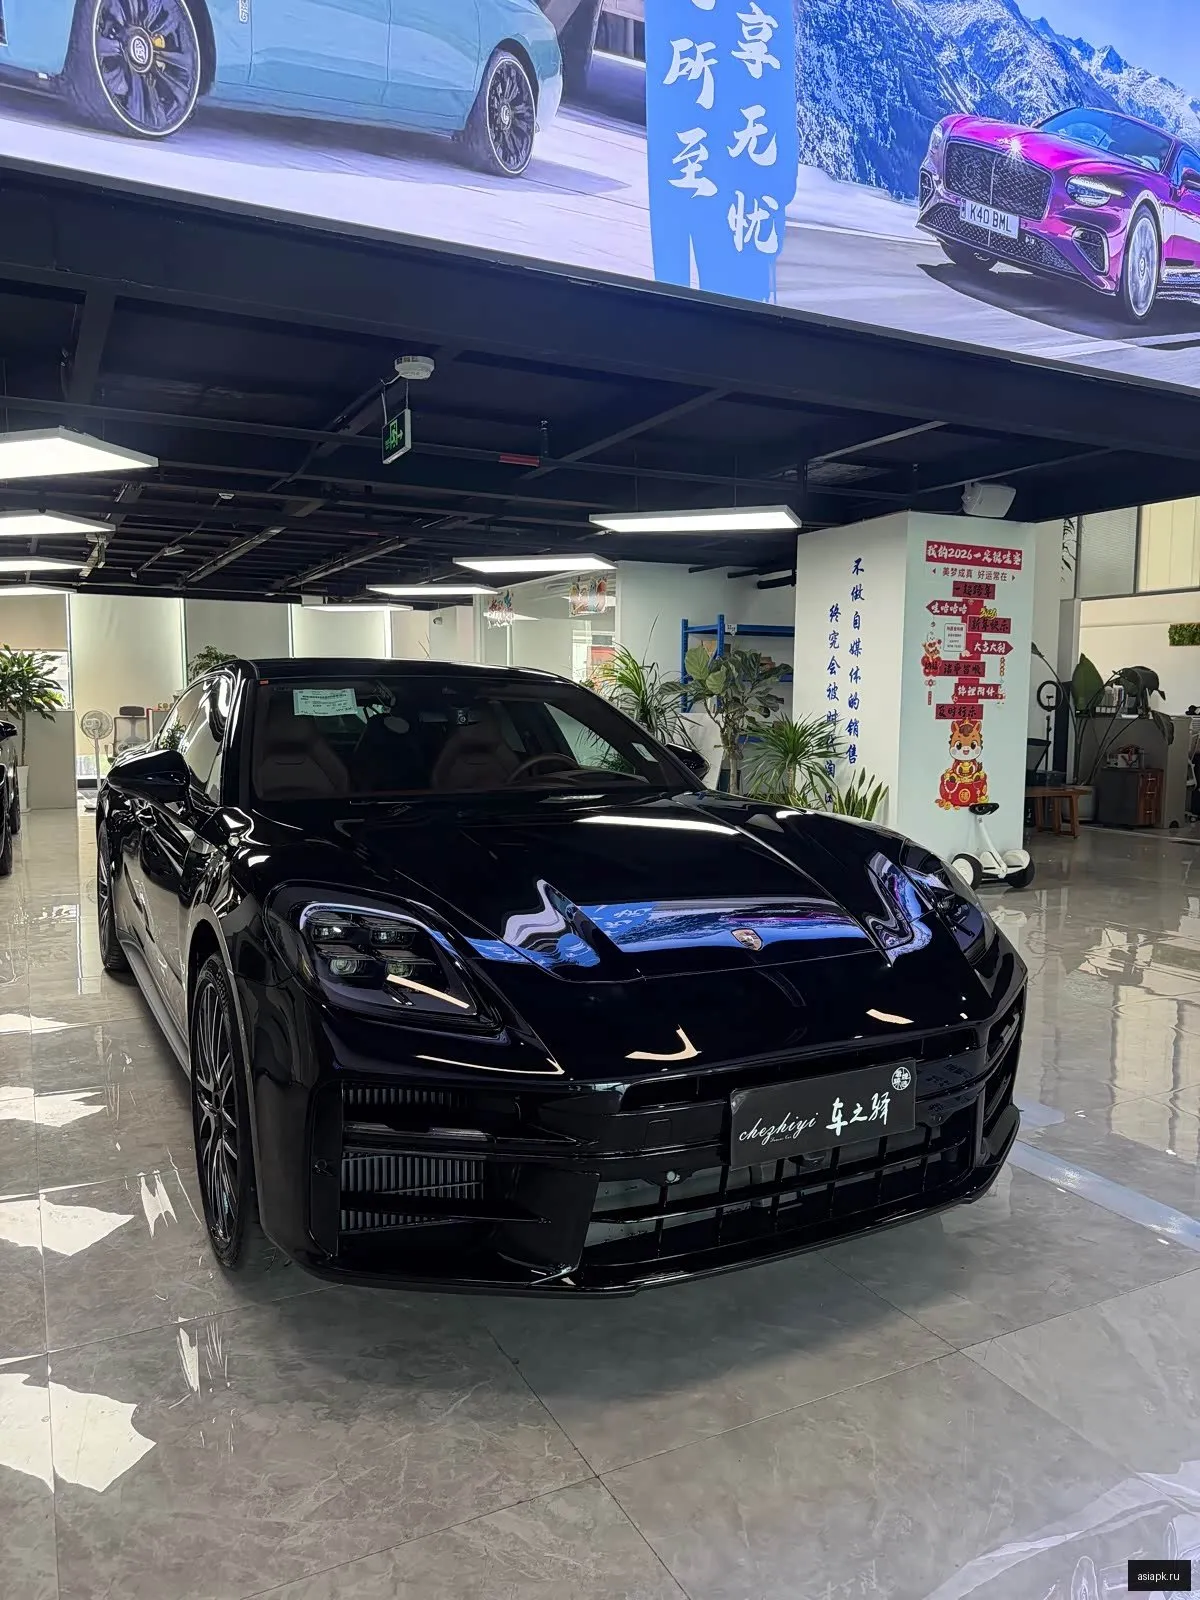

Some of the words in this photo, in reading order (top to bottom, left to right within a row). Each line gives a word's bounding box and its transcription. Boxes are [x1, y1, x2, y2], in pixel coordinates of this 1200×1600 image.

[662, 0, 719, 197] 所至
[727, 2, 781, 253] 享无忧
[970, 203, 991, 225] K40
[992, 210, 1012, 233] BML
[845, 557, 865, 764] 不做自媒体的销售
[974, 641, 1006, 654] 大吉大利
[739, 1111, 819, 1146] chezhiyi
